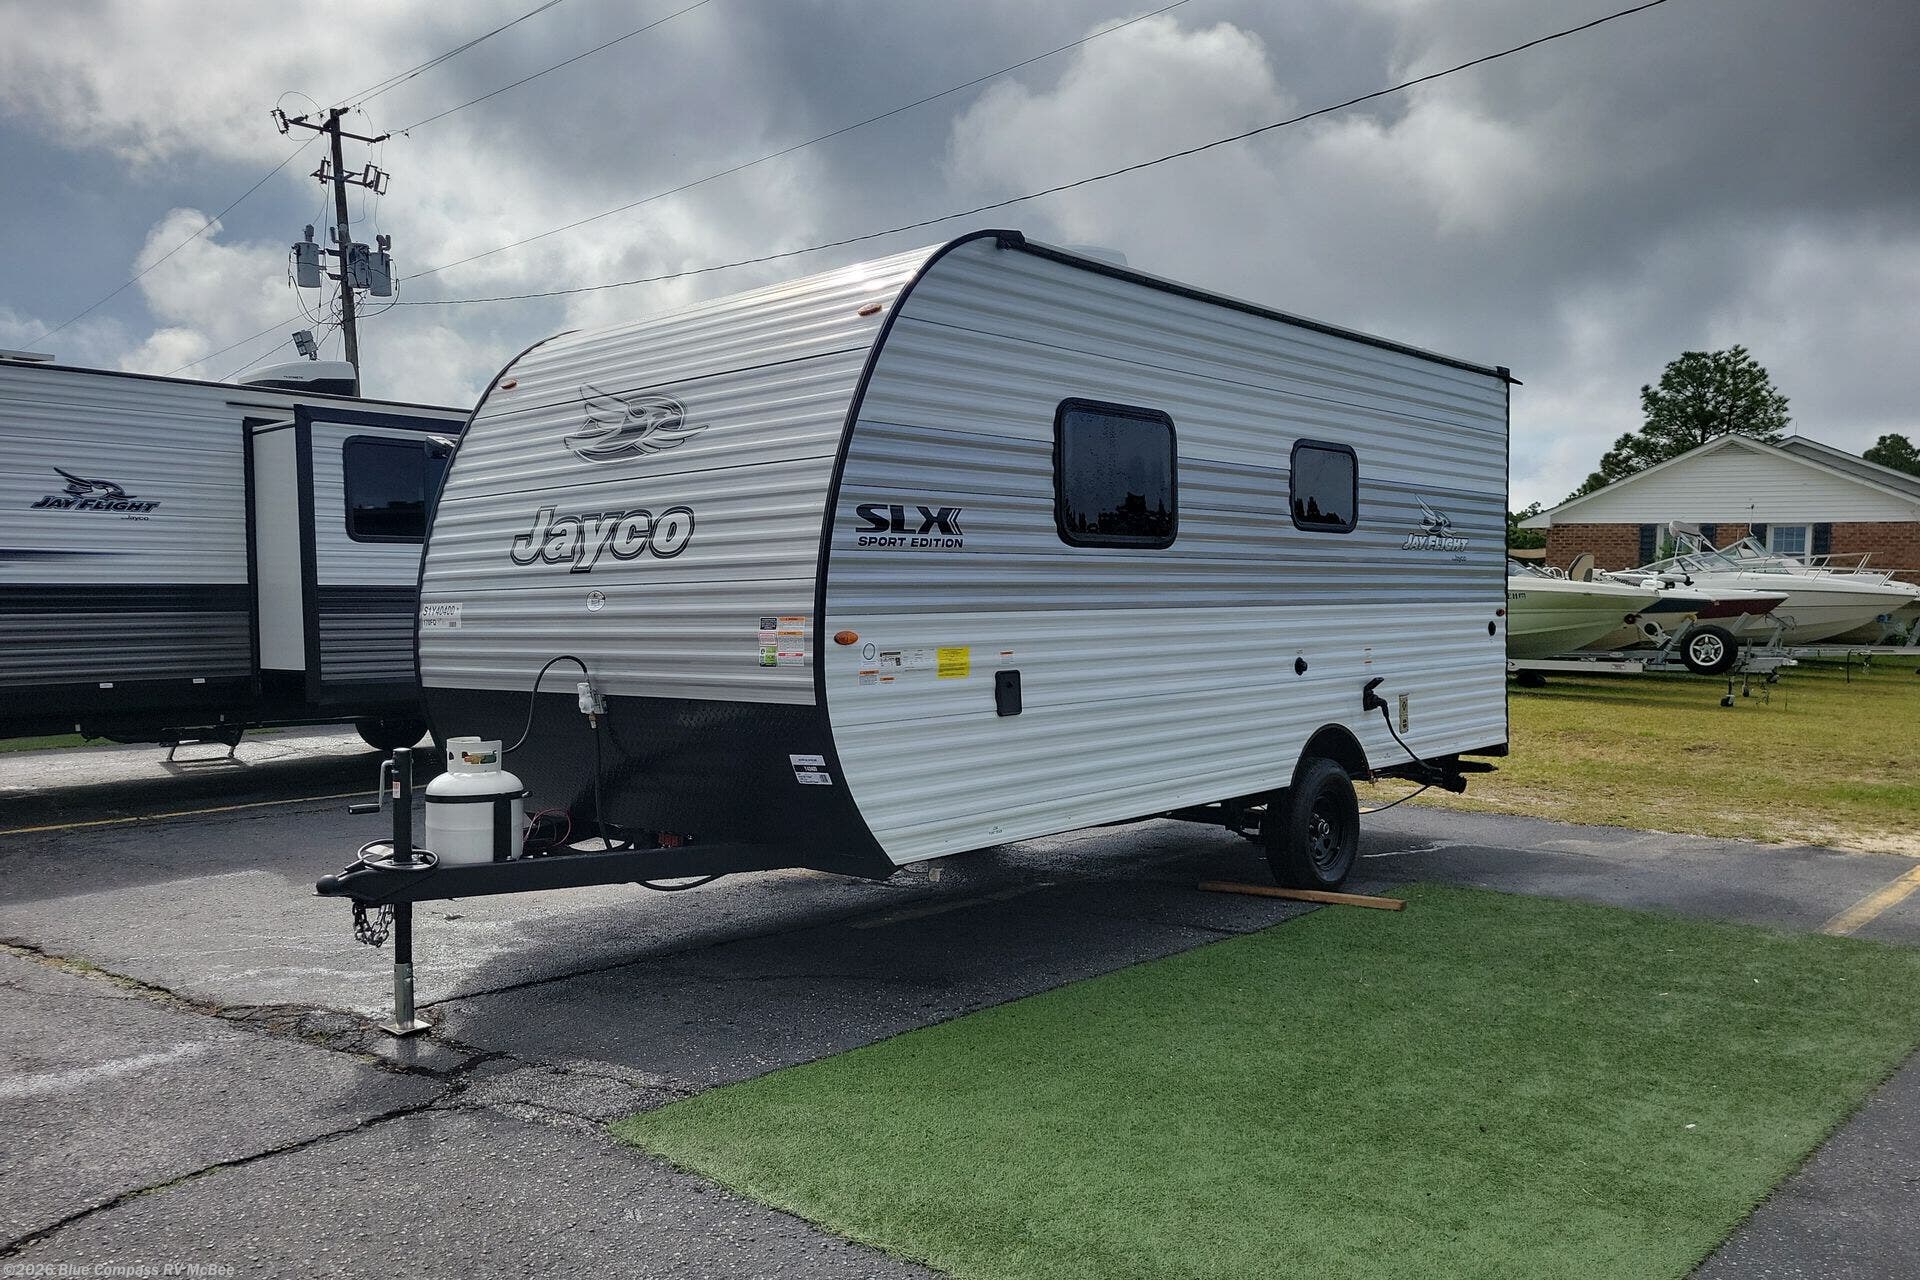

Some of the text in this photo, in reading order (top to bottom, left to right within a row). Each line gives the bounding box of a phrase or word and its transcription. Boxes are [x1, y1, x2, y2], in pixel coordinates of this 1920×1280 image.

[30, 495, 161, 513] JAY FLIGHT
[855, 503, 964, 535] SLX
[510, 504, 696, 574] Jayco
[857, 536, 964, 548] SPORT EDITION
[1401, 533, 1470, 552] JAY FLIGHT
